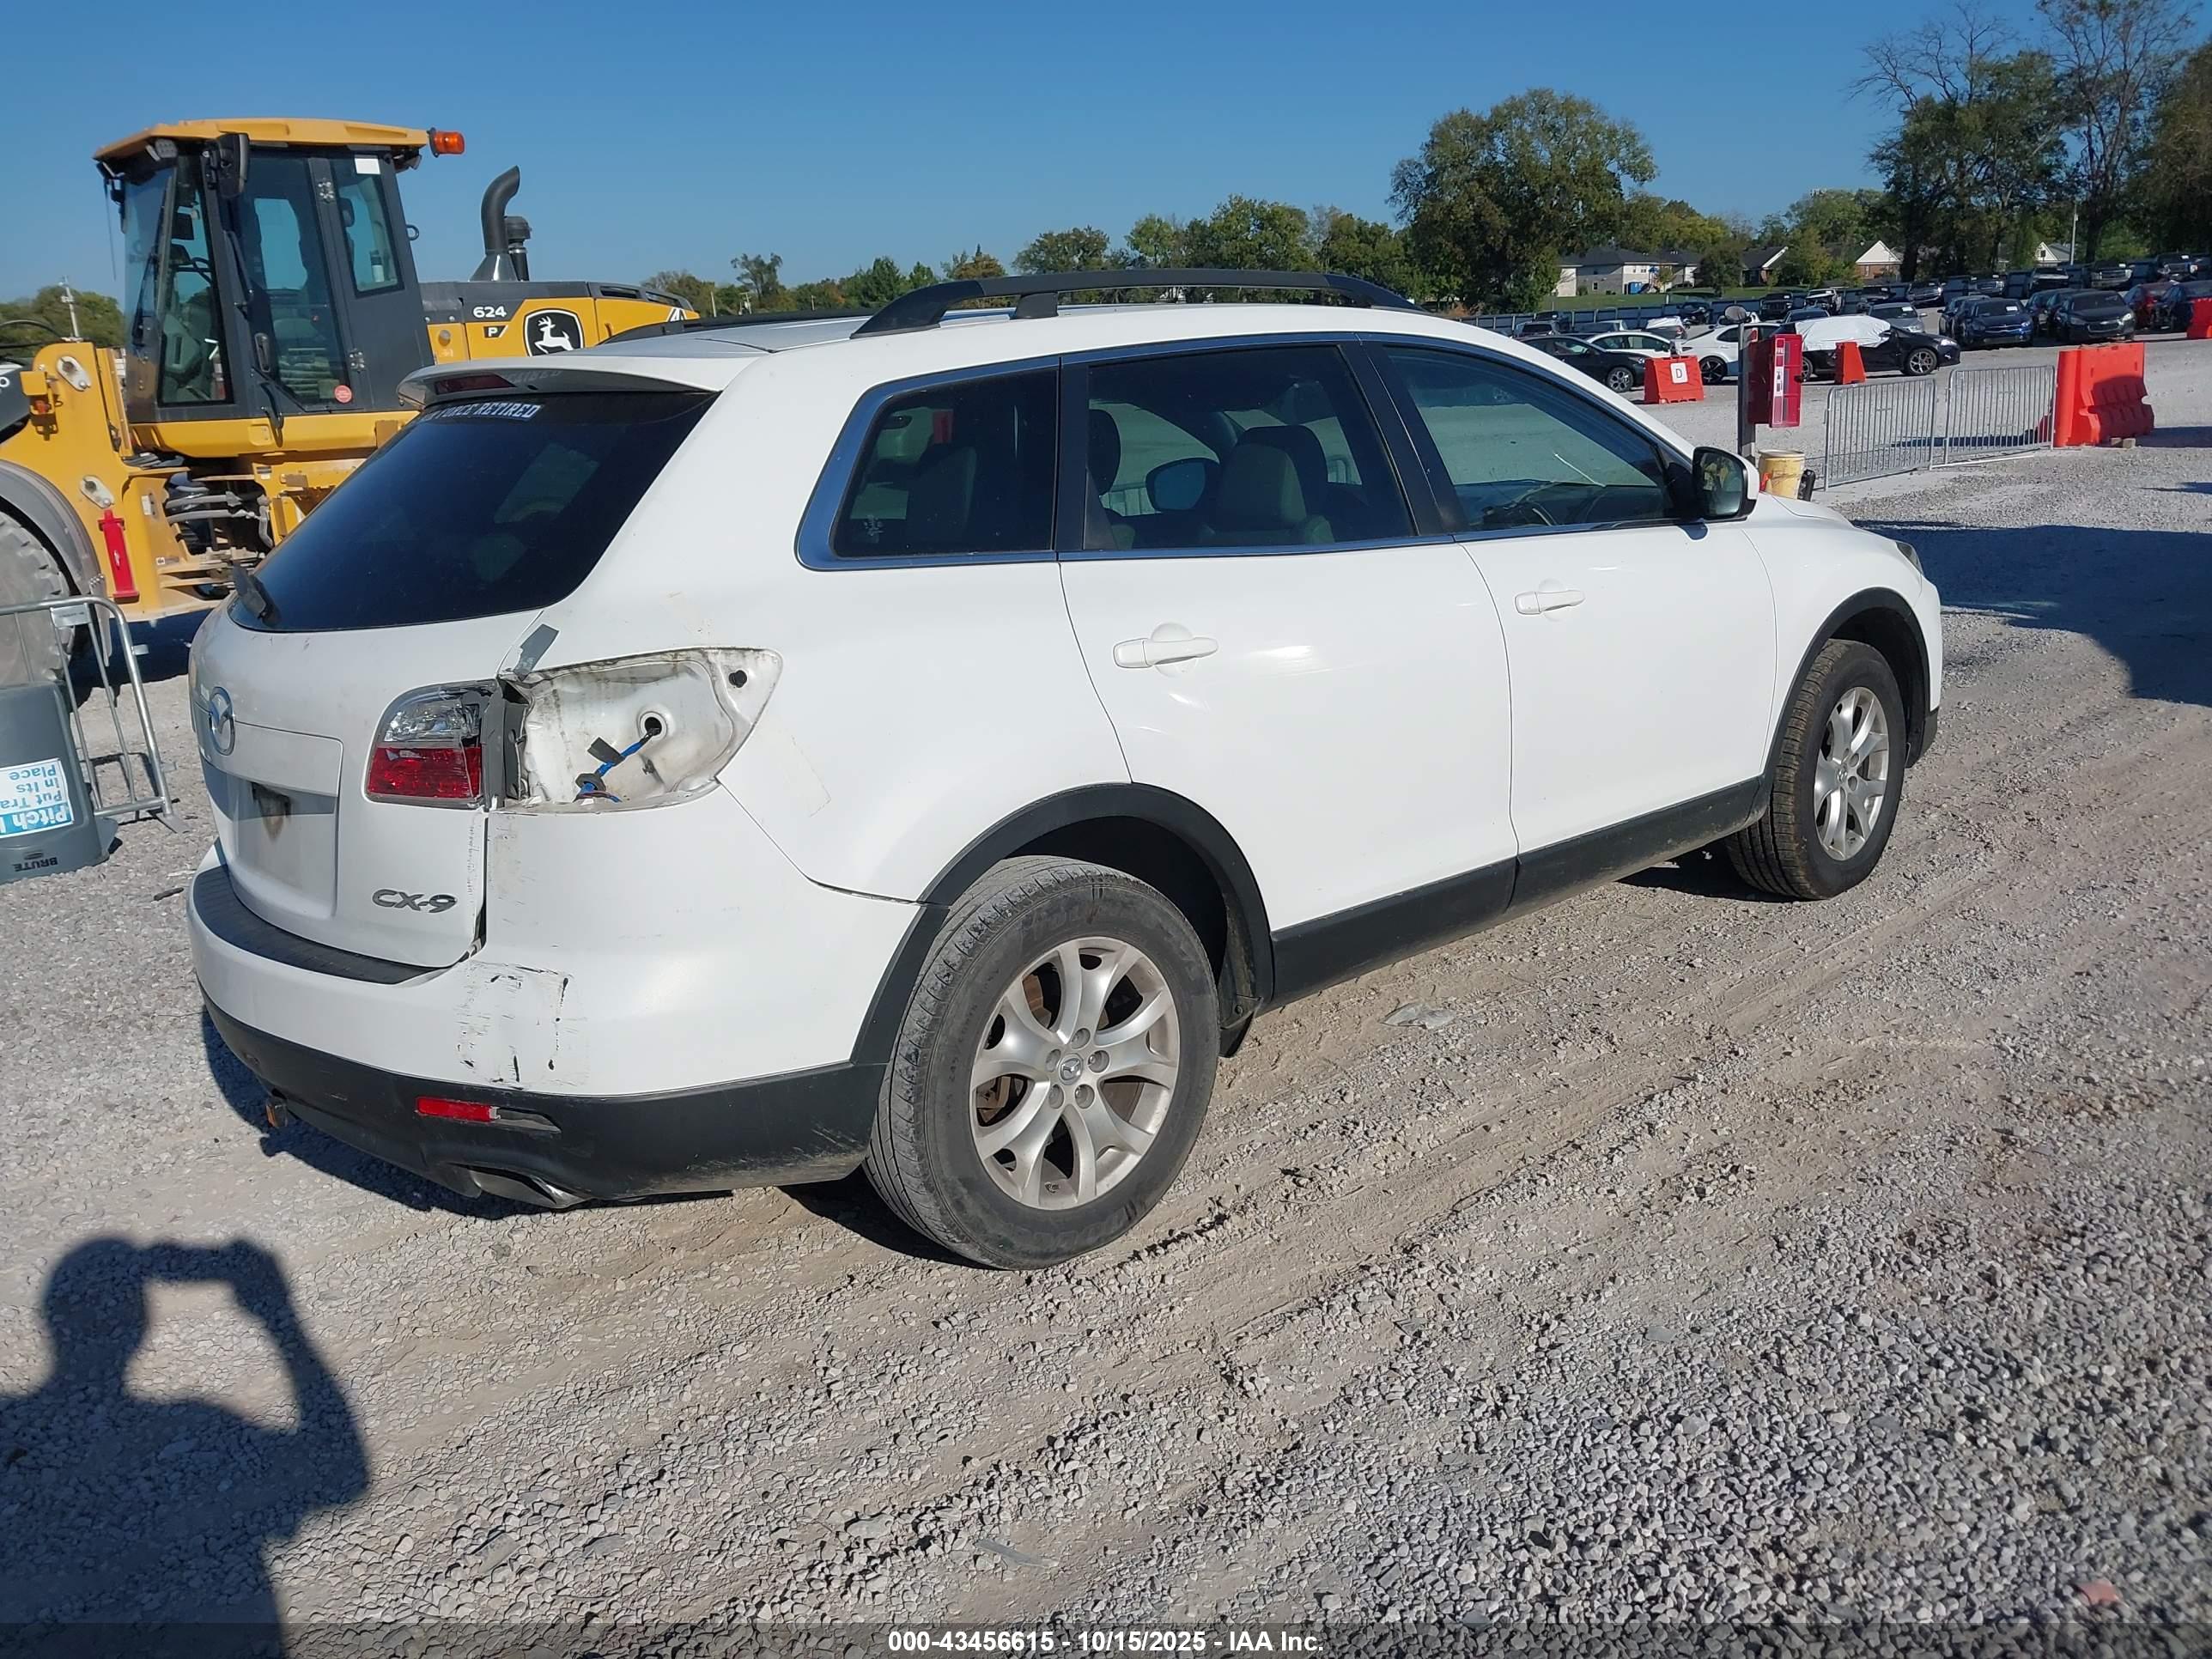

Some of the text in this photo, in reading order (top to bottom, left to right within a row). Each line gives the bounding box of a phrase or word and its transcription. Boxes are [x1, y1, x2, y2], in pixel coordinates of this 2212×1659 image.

[473, 306, 507, 319] 624
[488, 326, 498, 337] P
[1675, 368, 1683, 379] D
[473, 402, 542, 418] RETIRED
[9, 764, 57, 781] Place
[15, 781, 40, 793] Its
[0, 790, 63, 810] Put Tra
[12, 805, 69, 830] Pitch
[12, 857, 58, 872] BRUTE
[372, 889, 457, 913] CX-9
